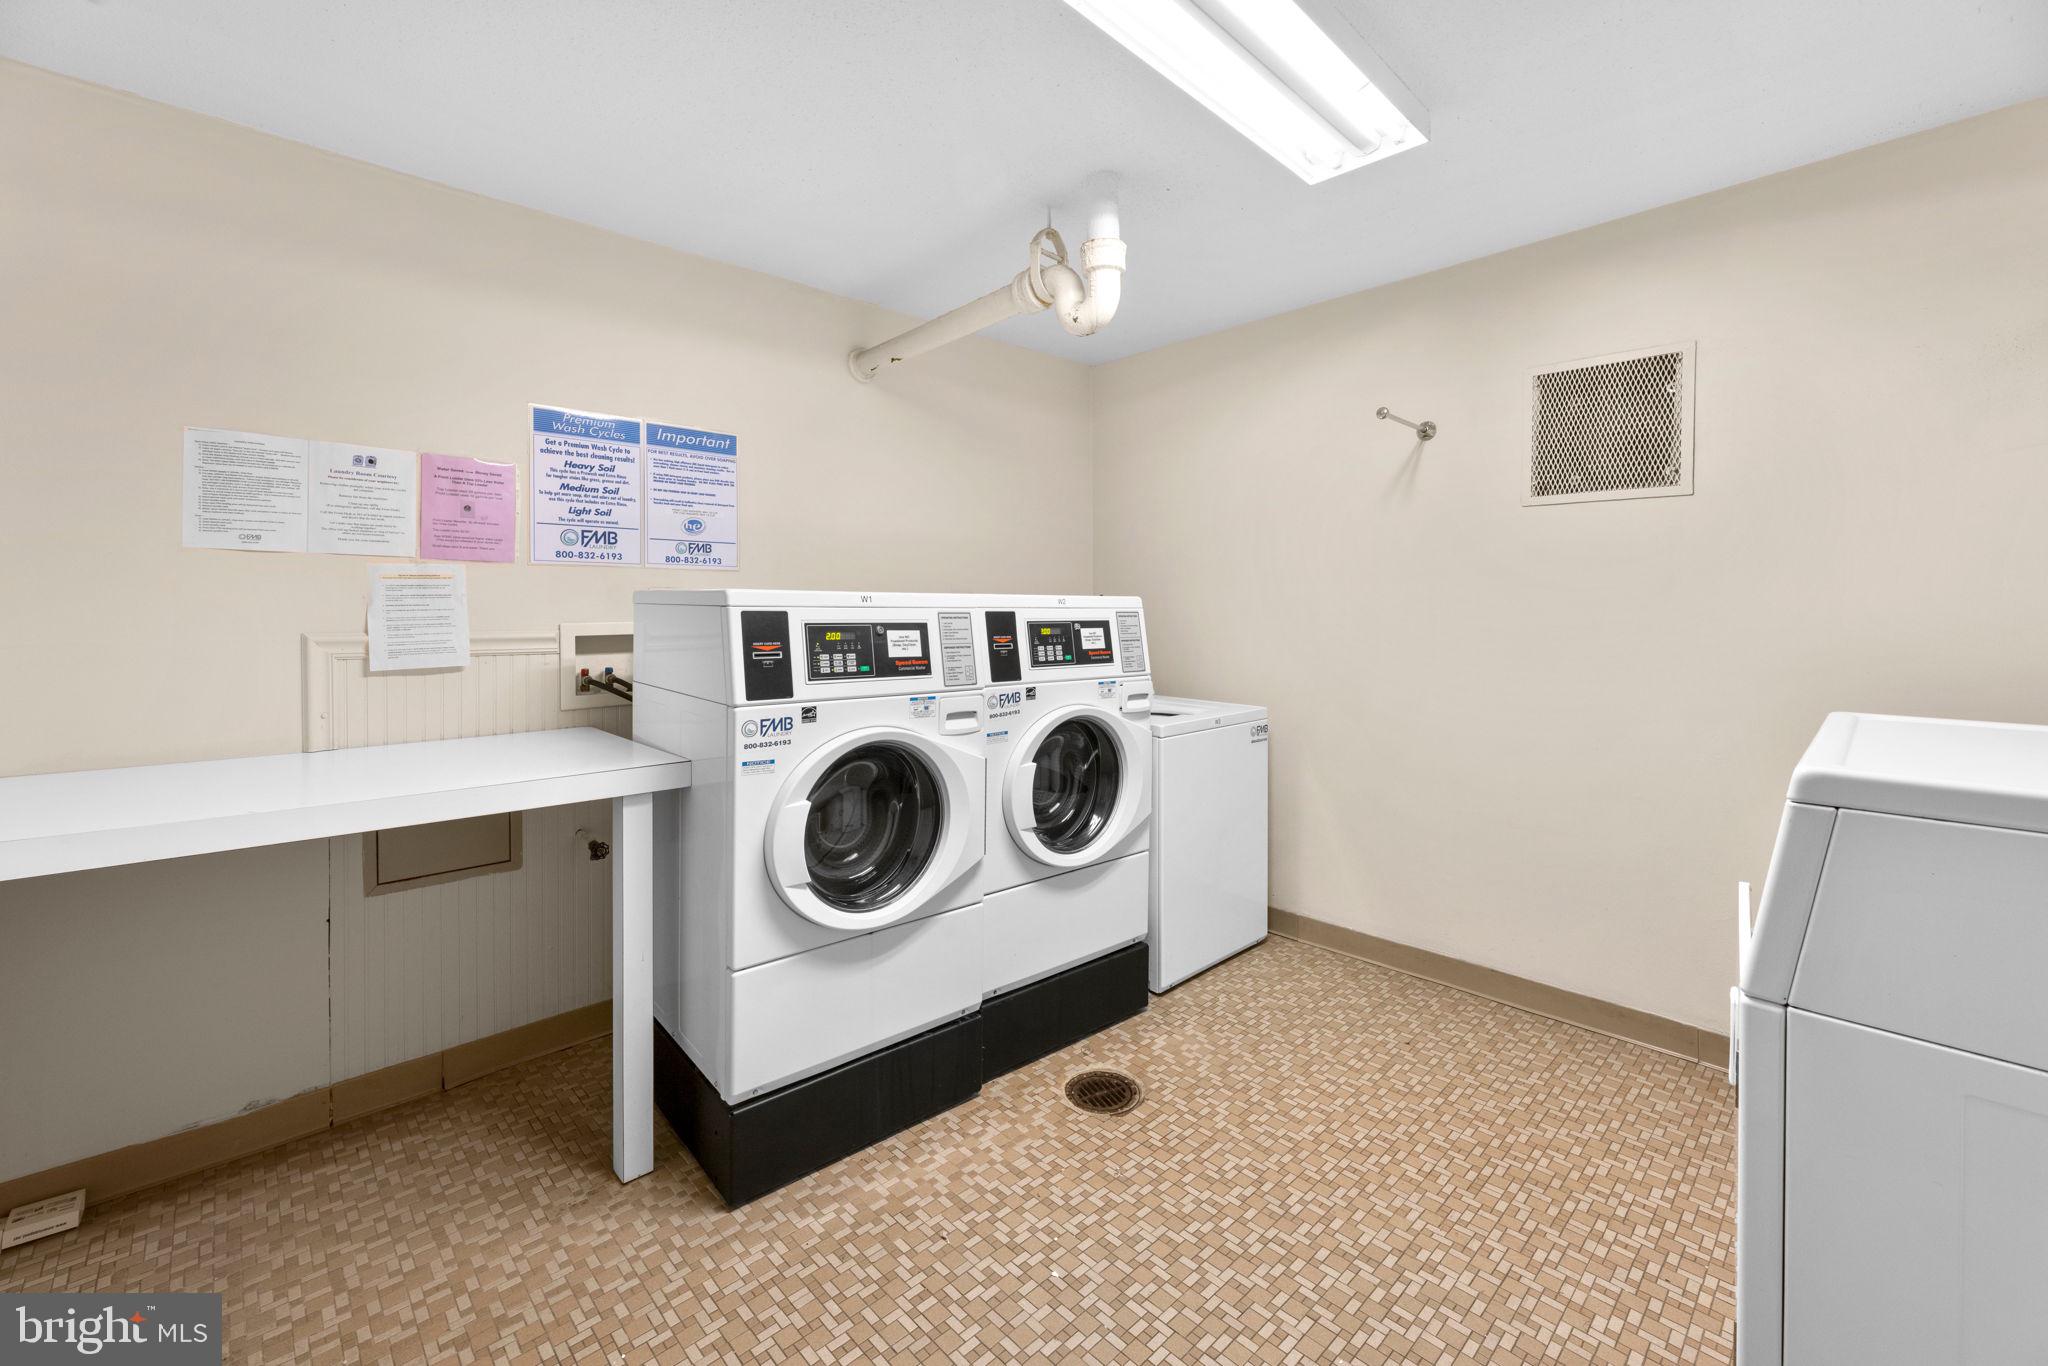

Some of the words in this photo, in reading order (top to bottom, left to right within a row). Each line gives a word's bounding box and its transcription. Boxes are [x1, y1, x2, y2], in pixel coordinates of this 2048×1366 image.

[562, 412, 616, 428] Premium
[552, 421, 585, 434] Wash
[590, 426, 626, 440] Cycles
[657, 428, 730, 449] Important
[545, 438, 556, 446] Get
[564, 440, 590, 450] Premium
[591, 443, 607, 452] Wash
[609, 446, 623, 455] Cycle
[540, 446, 563, 455] achieve
[576, 450, 588, 458] best
[590, 452, 613, 463] cleaning
[614, 455, 636, 464] results!
[564, 460, 596, 472] Heavy
[598, 464, 616, 472] Soil
[373, 472, 397, 480] Courtesy
[560, 483, 599, 494] Medium
[602, 487, 620, 496] Soil
[568, 506, 592, 517] Light
[594, 508, 612, 517] Soil
[581, 530, 618, 547] FMB
[556, 551, 622, 560] 800-832-6193
[688, 543, 712, 555] FMB
[665, 556, 722, 565] 800-832-6193
[999, 692, 1021, 708] FMB
[760, 717, 793, 737] FMB
[1257, 724, 1268, 736] FMB
[744, 740, 791, 749] 800-832-6193
